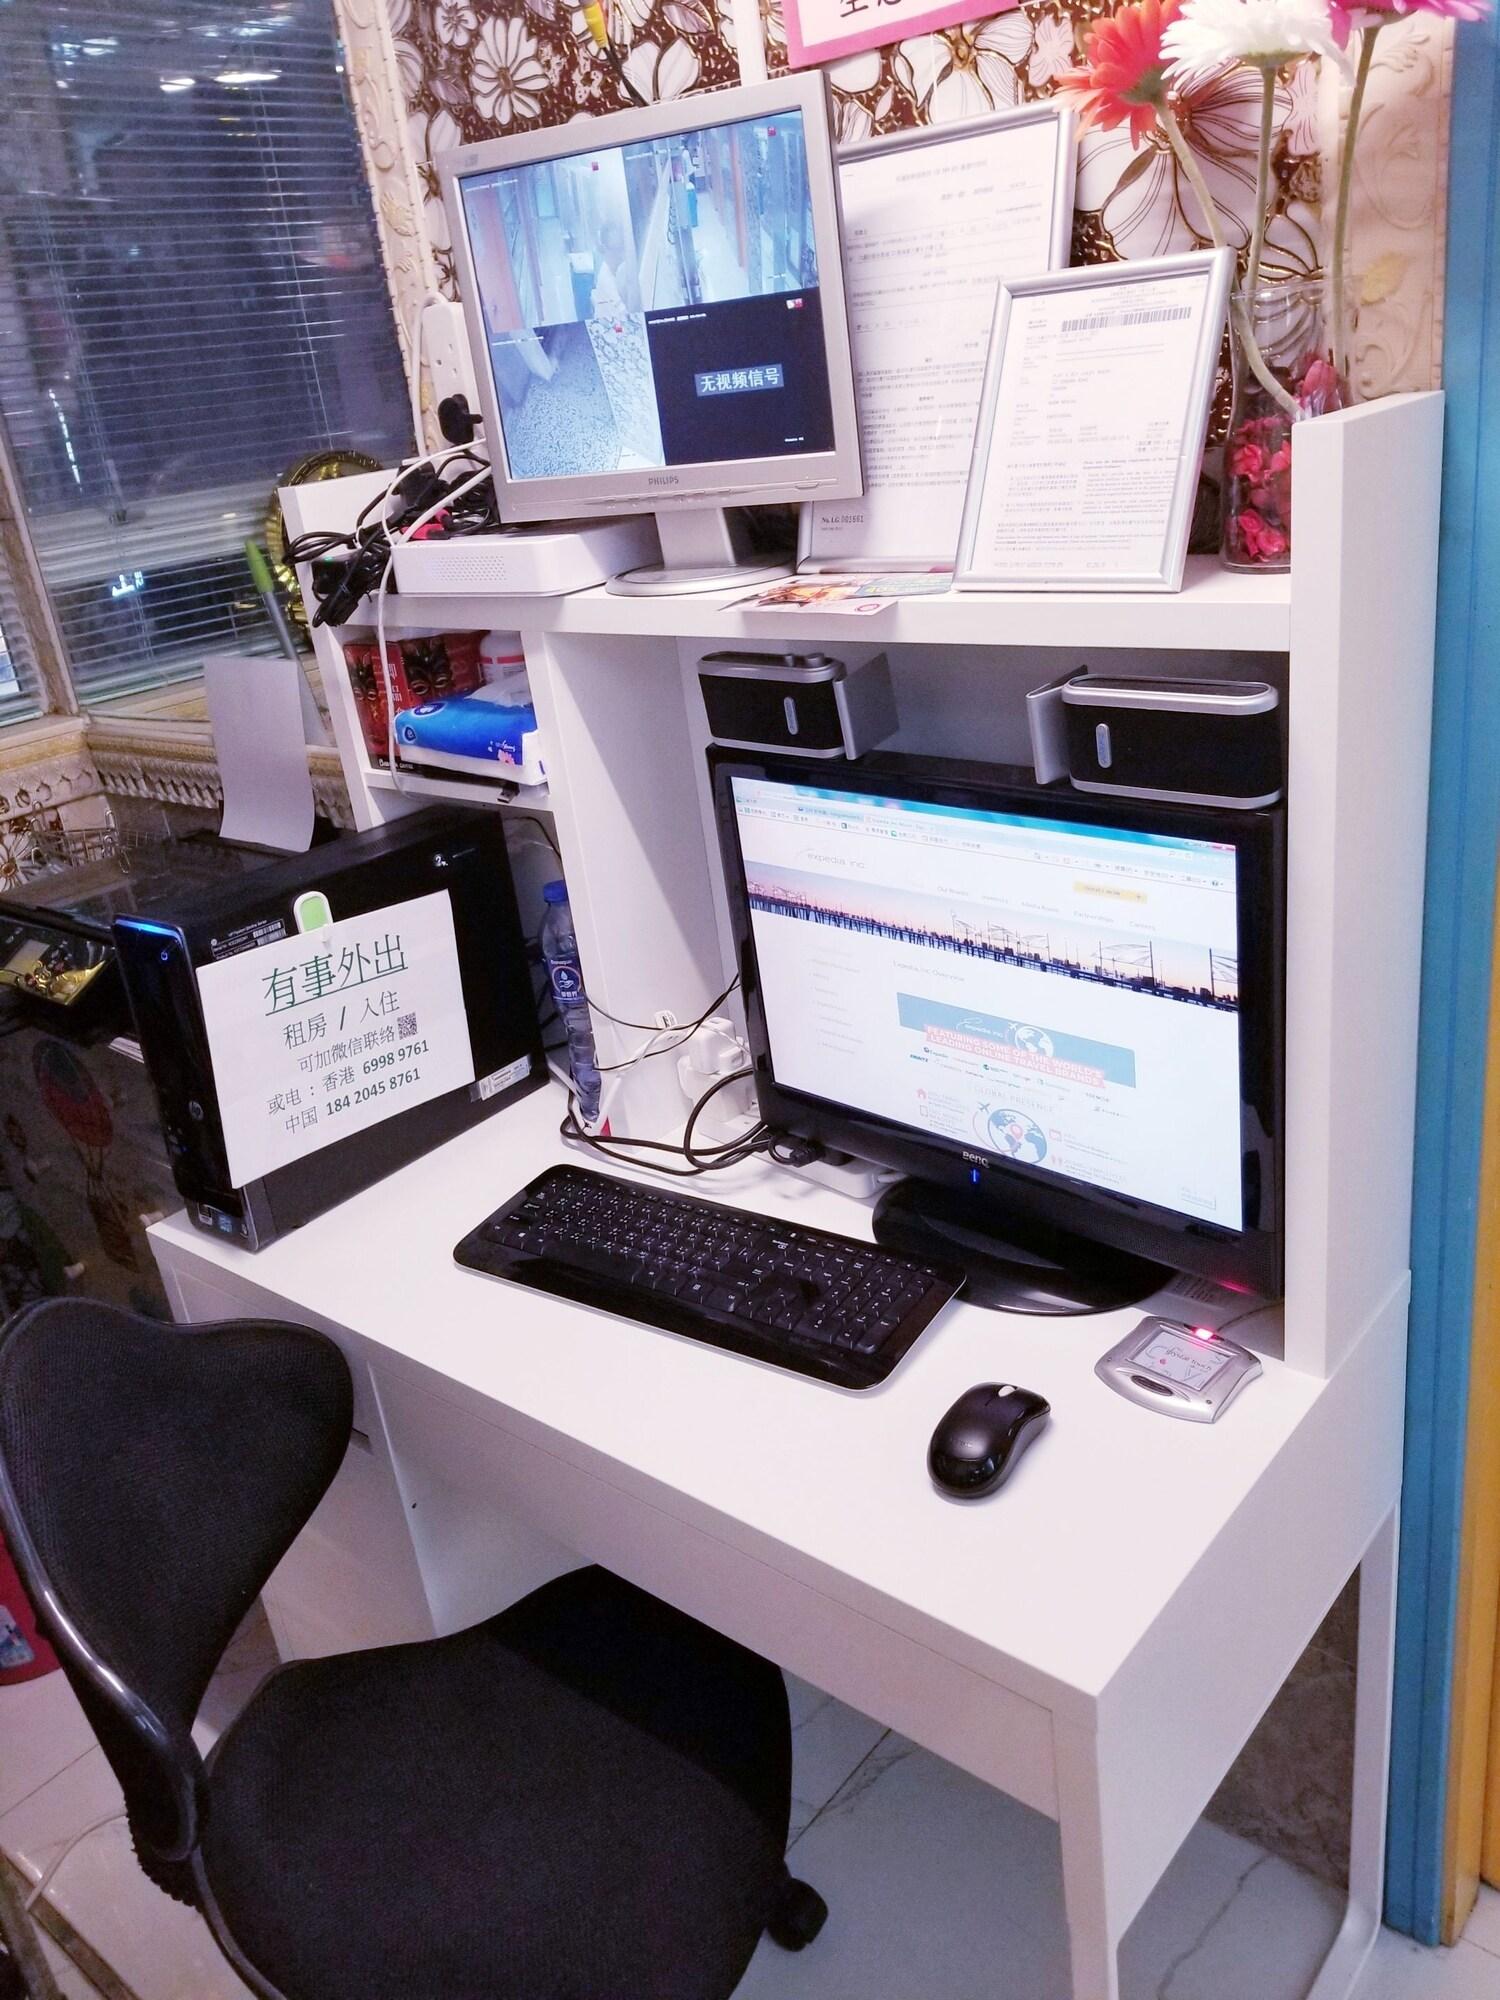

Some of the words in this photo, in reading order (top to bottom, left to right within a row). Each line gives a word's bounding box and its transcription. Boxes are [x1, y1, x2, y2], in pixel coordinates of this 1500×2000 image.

[700, 366, 780, 393] 无视频信号
[648, 475, 679, 486] PHILIPS
[262, 933, 409, 1013] 有事外出
[283, 1012, 328, 1050] 租房
[360, 990, 400, 1024] 入住
[297, 1024, 396, 1074] 可加微信联络
[361, 1051, 395, 1075] 6998
[397, 1039, 430, 1063] 9761
[927, 1026, 981, 1046] FEATURING
[982, 1037, 1012, 1053] SOME
[1012, 1048, 1028, 1058] OF
[1030, 1051, 1049, 1065] THE
[930, 1034, 972, 1051] LEADING
[973, 1046, 1013, 1063] ONLINE
[1014, 1055, 1053, 1073] TRAVEL
[1054, 1065, 1103, 1086] BRANDS
[285, 1106, 319, 1135] 中国
[326, 1095, 350, 1116] 184
[354, 1081, 386, 1104] 2045
[389, 1067, 421, 1091] 8761
